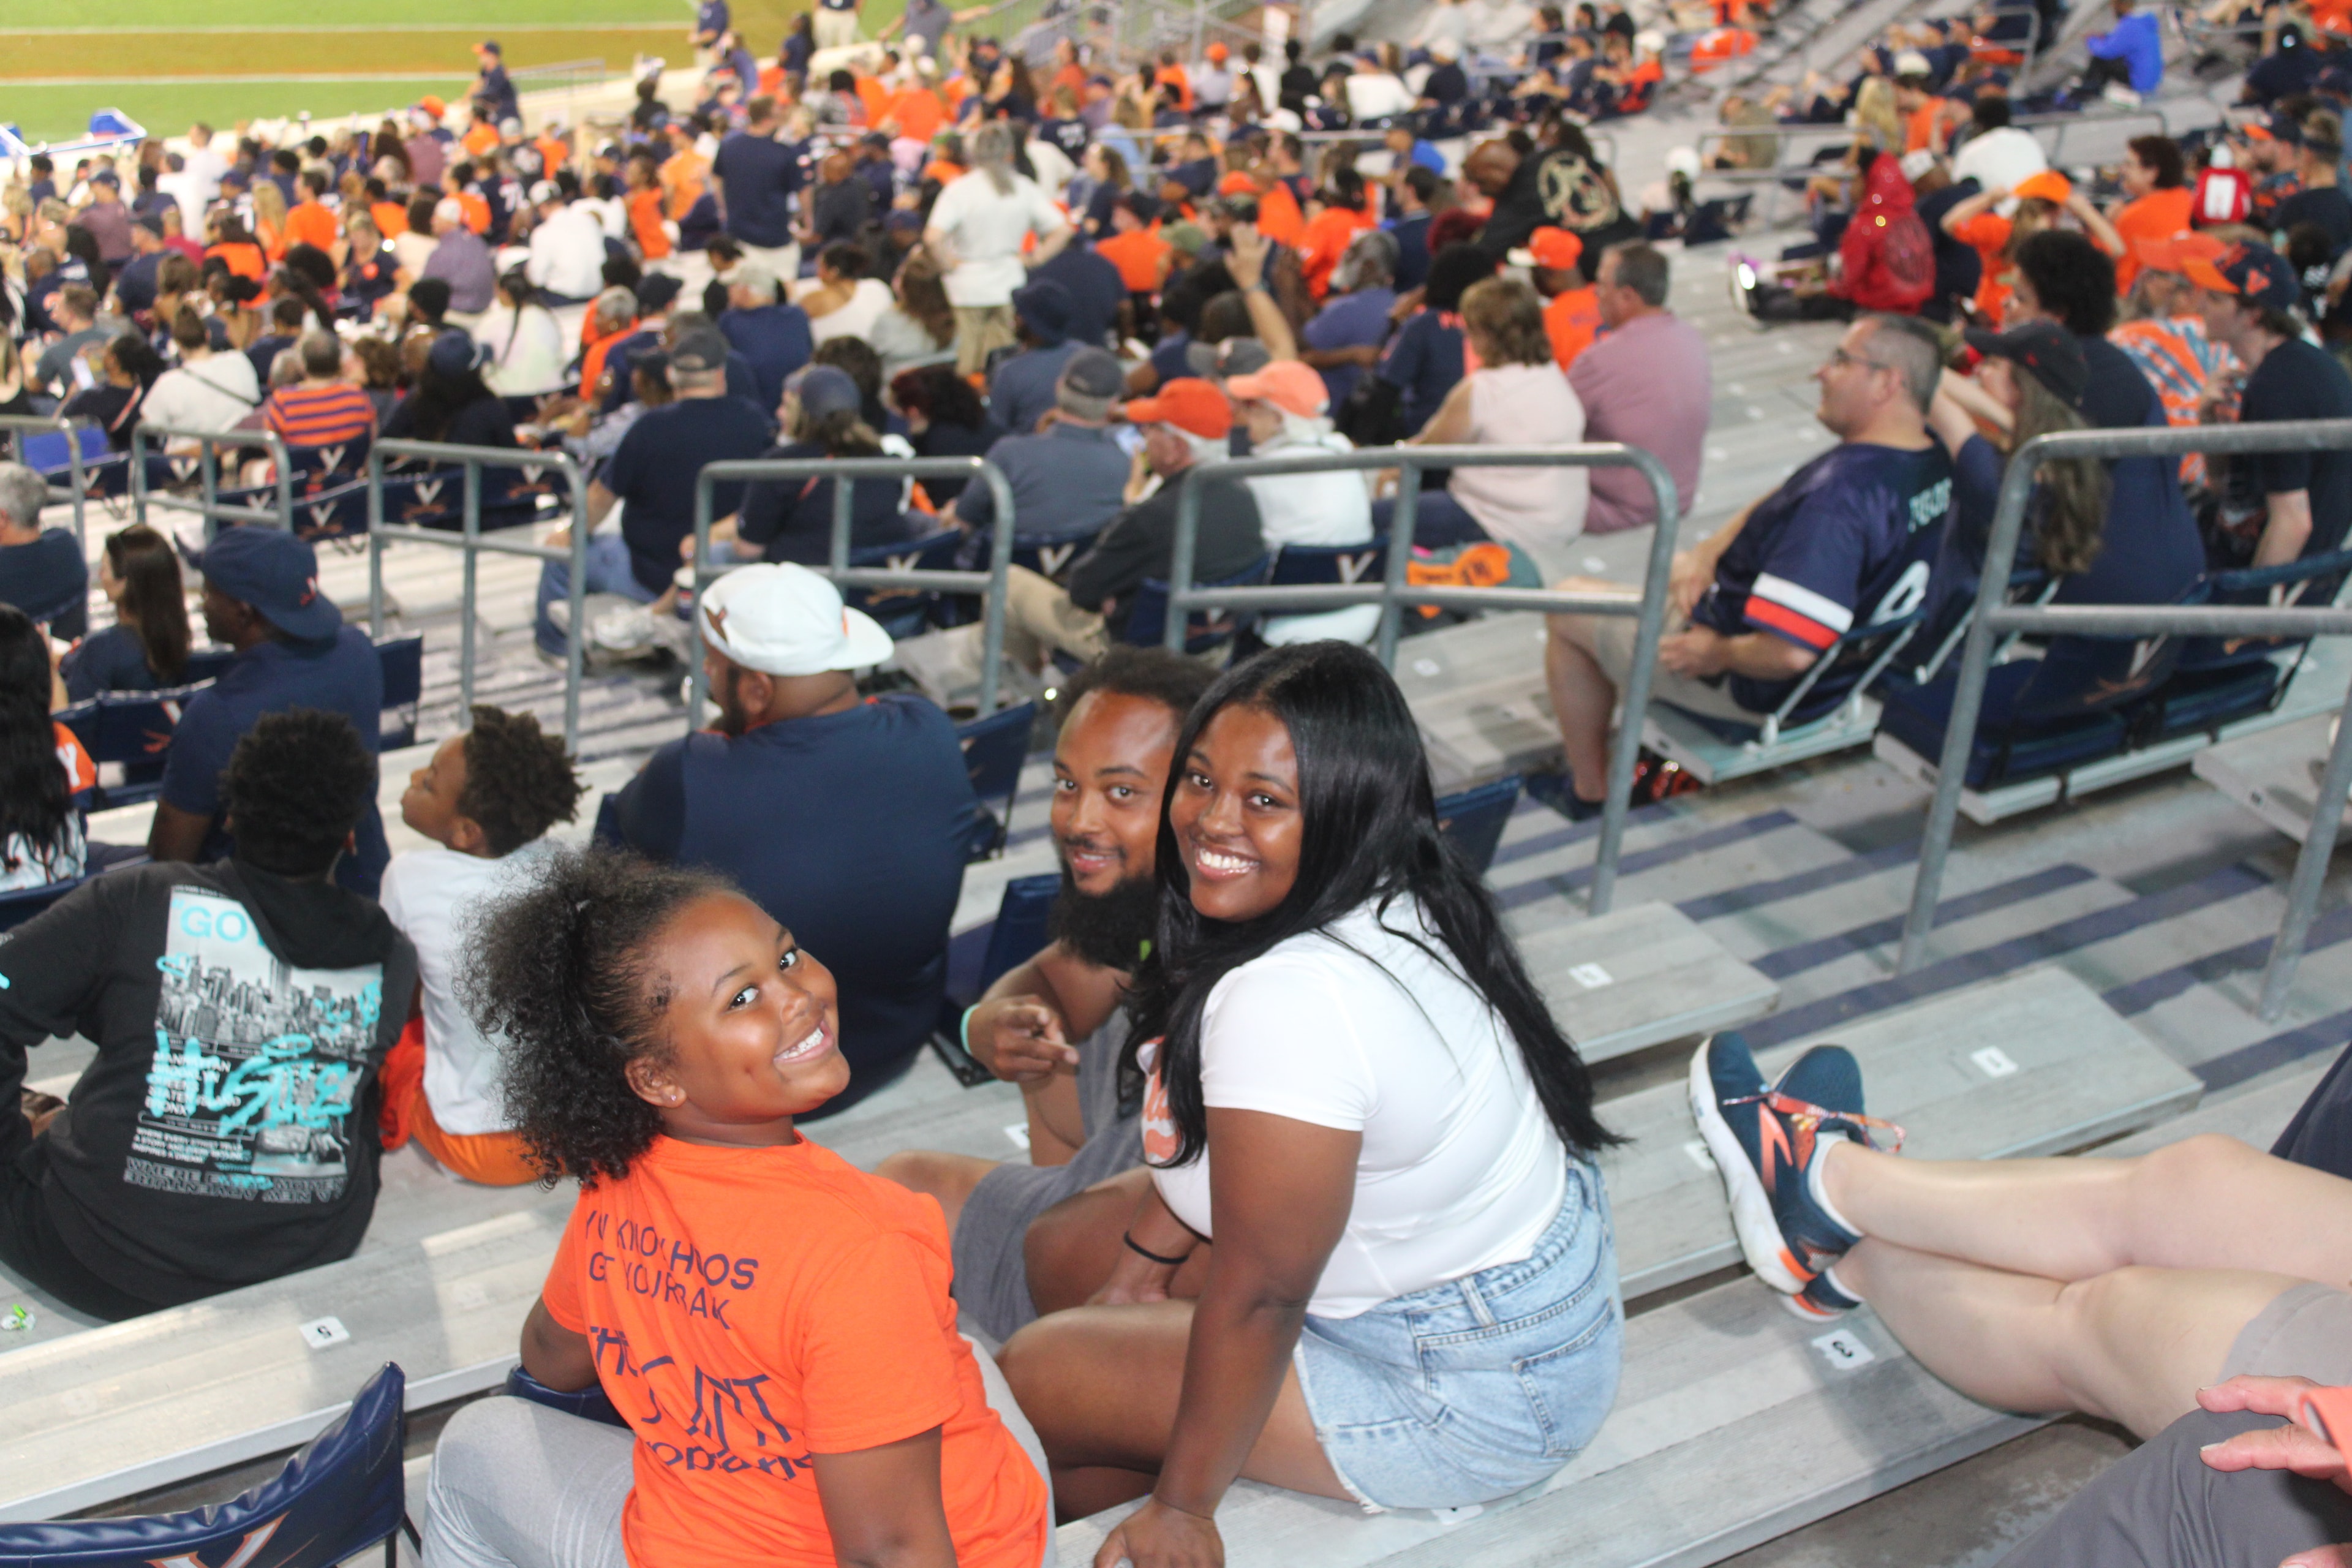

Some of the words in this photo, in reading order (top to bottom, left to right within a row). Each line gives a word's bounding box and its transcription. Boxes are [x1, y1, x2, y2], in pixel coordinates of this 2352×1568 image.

[412, 479, 443, 505] V
[309, 502, 337, 527] V
[1038, 543, 1076, 576] V
